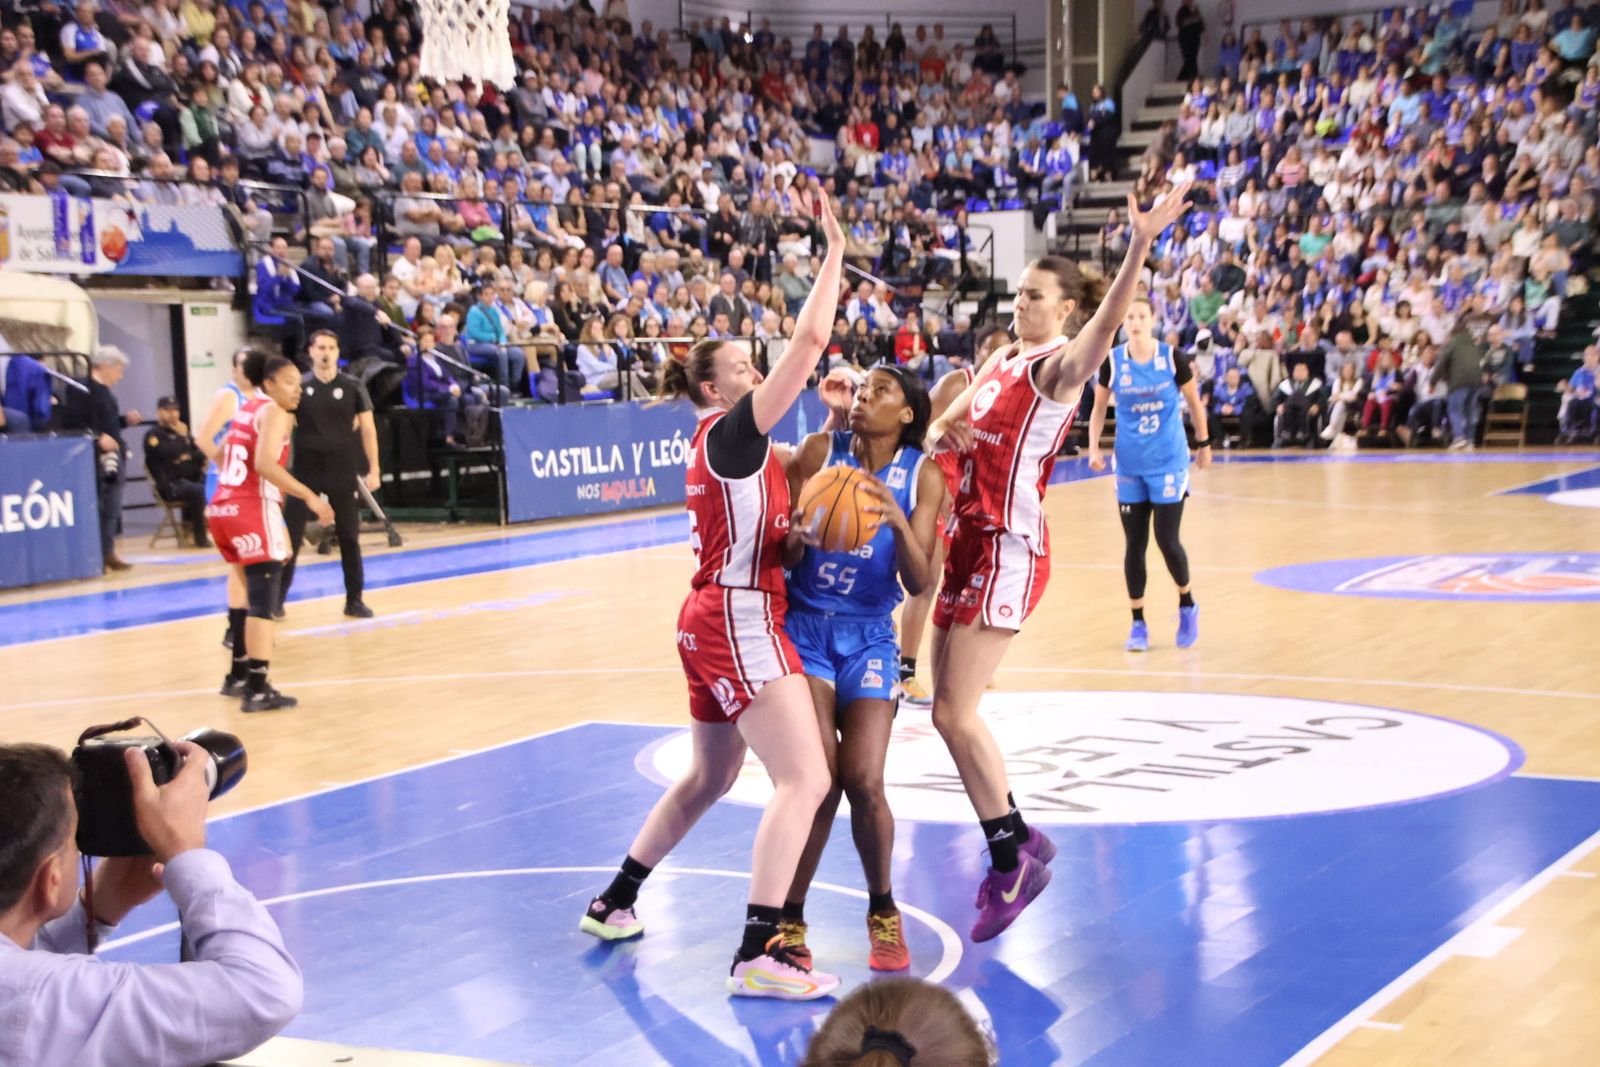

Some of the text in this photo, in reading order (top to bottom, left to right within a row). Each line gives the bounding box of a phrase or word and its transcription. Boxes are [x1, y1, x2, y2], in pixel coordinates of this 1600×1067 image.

[1138, 413, 1160, 435] 23
[219, 443, 248, 486] 16
[530, 444, 625, 478] CASTILLA
[631, 441, 644, 475] Y
[0, 479, 75, 534] EÓN
[577, 483, 600, 500] NOS
[815, 561, 858, 595] 55
